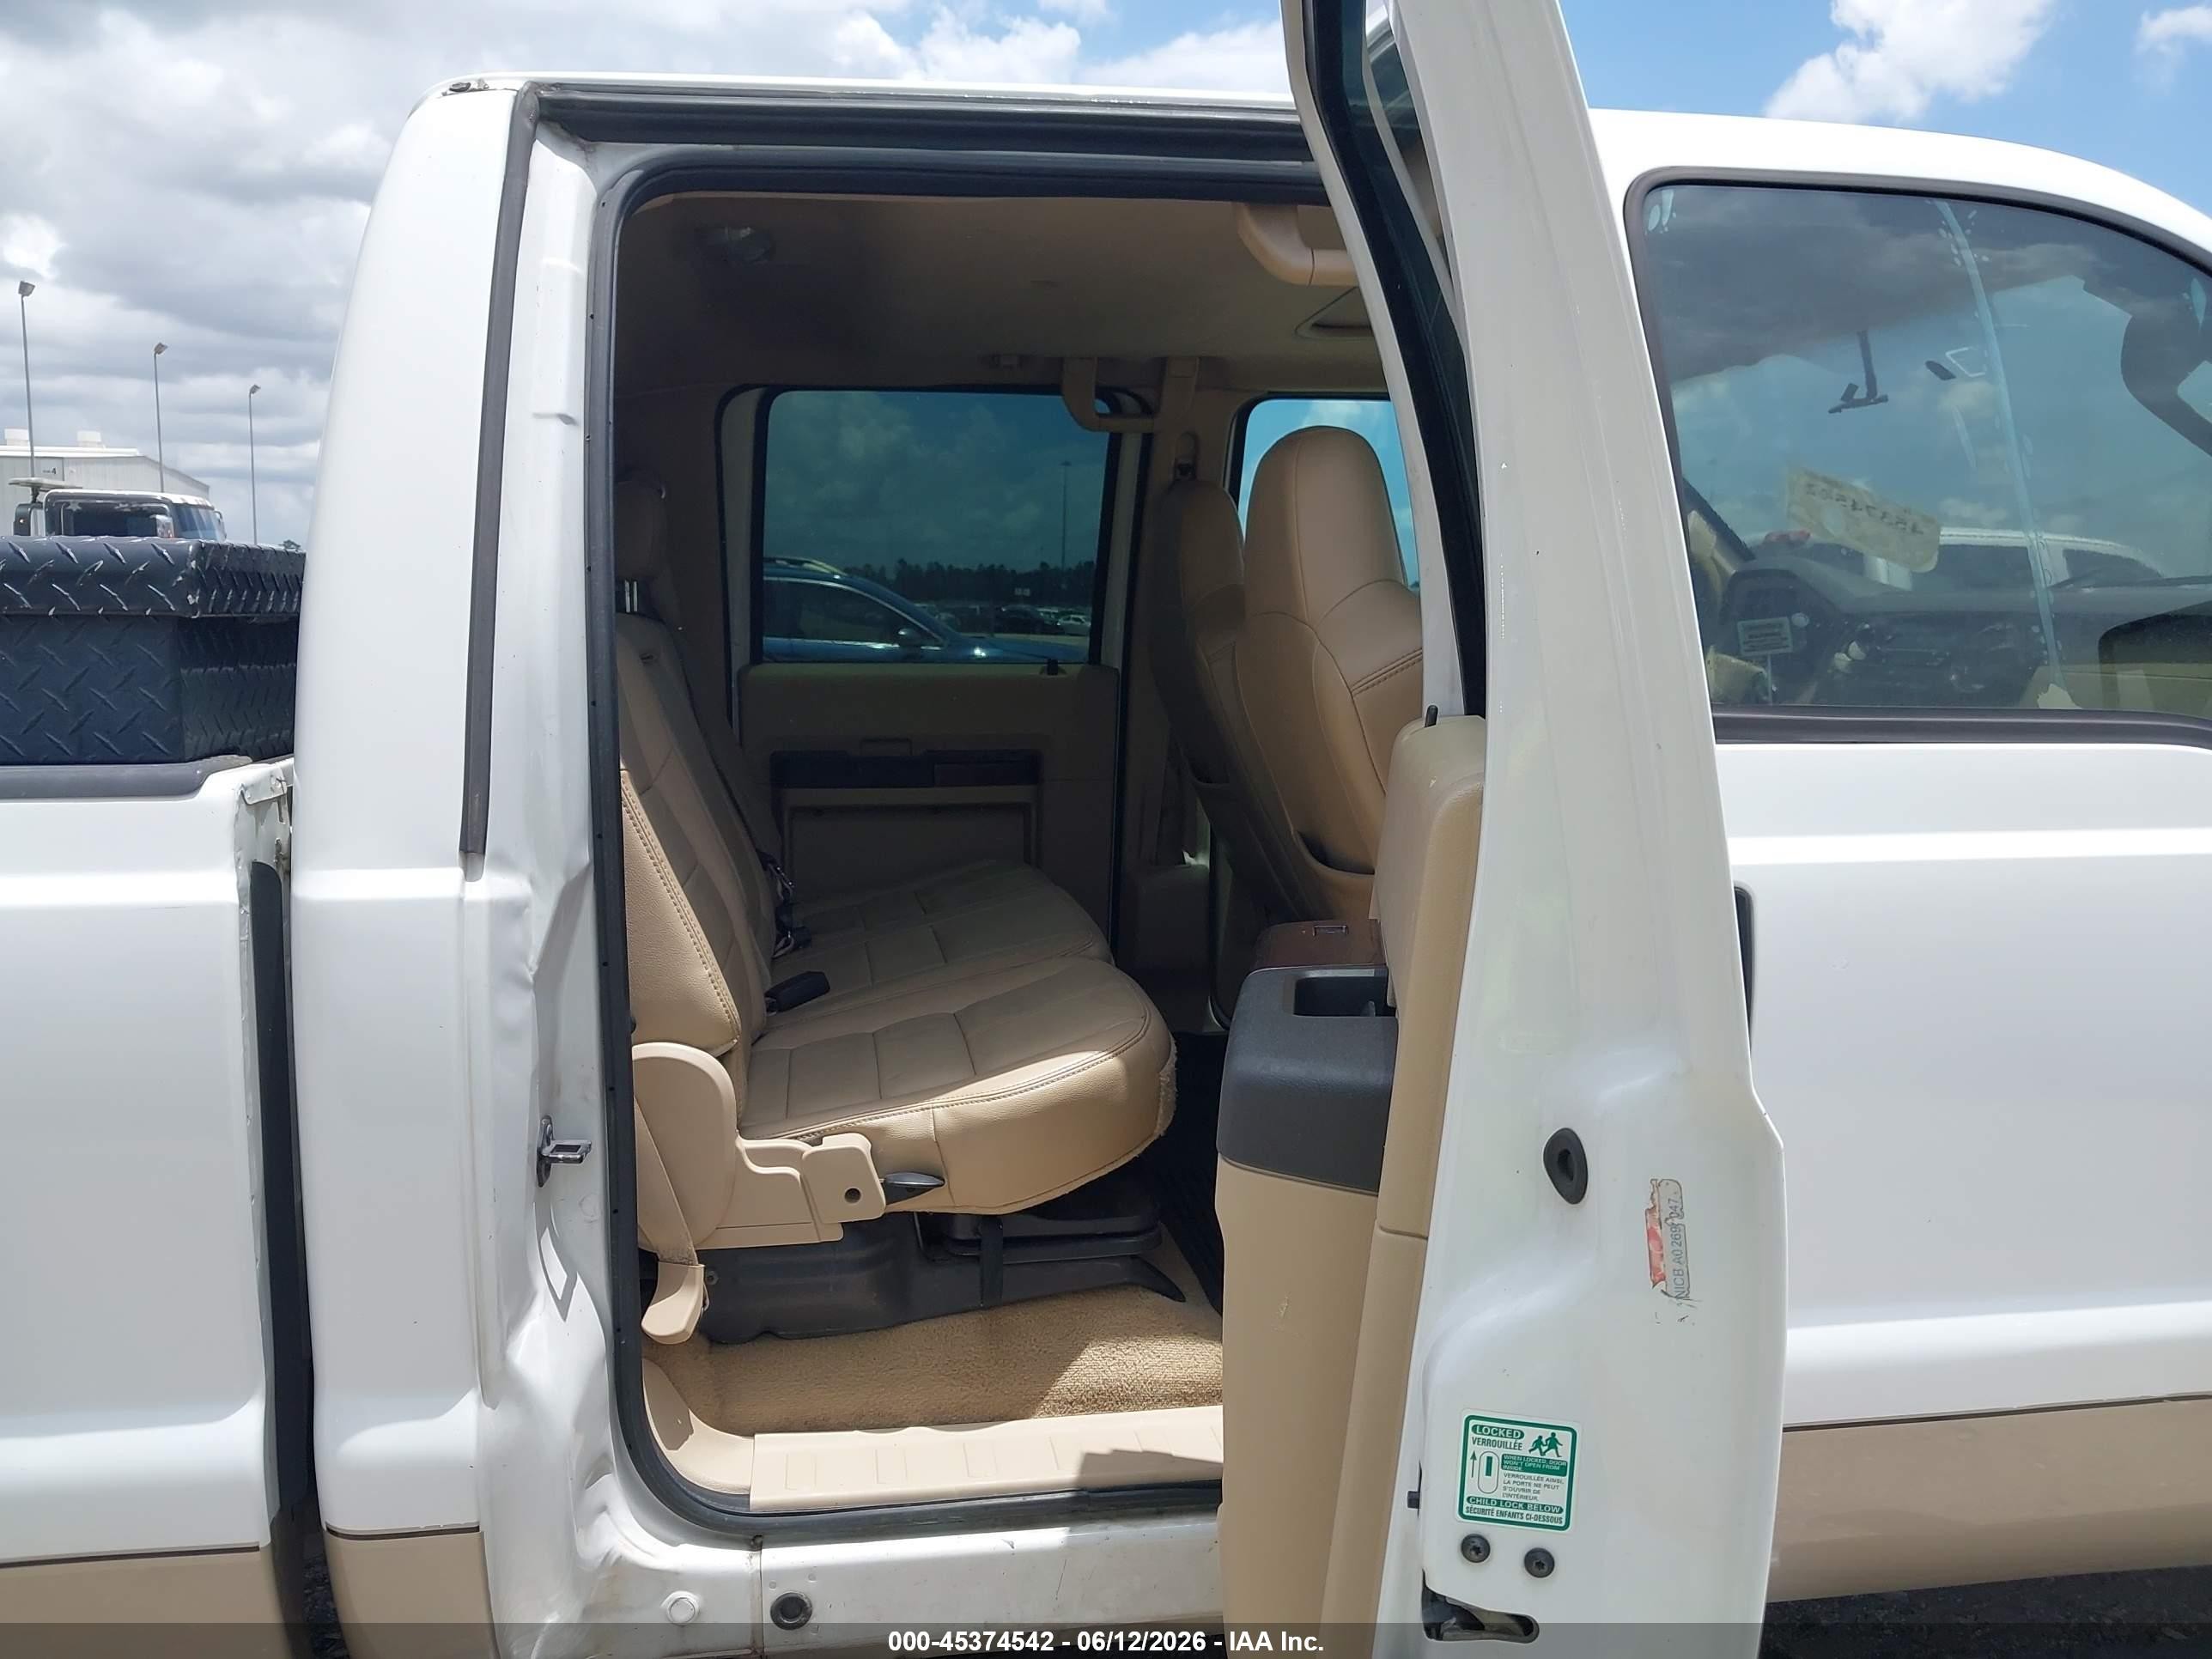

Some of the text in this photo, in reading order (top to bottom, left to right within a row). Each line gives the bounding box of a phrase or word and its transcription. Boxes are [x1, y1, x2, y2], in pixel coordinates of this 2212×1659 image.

[1673, 1269, 1686, 1298] NICB
[1477, 1425, 1522, 1438] LOCKED
[1472, 1437, 1522, 1451] VERROUILLÉE
[1504, 1473, 1544, 1482] VERROUILLÉE
[1469, 1497, 1560, 1513] CHILD LOCK BELOW
[1465, 1505, 1563, 1524] SÉCURITÉ ENFANTS CI-DESSOUS
